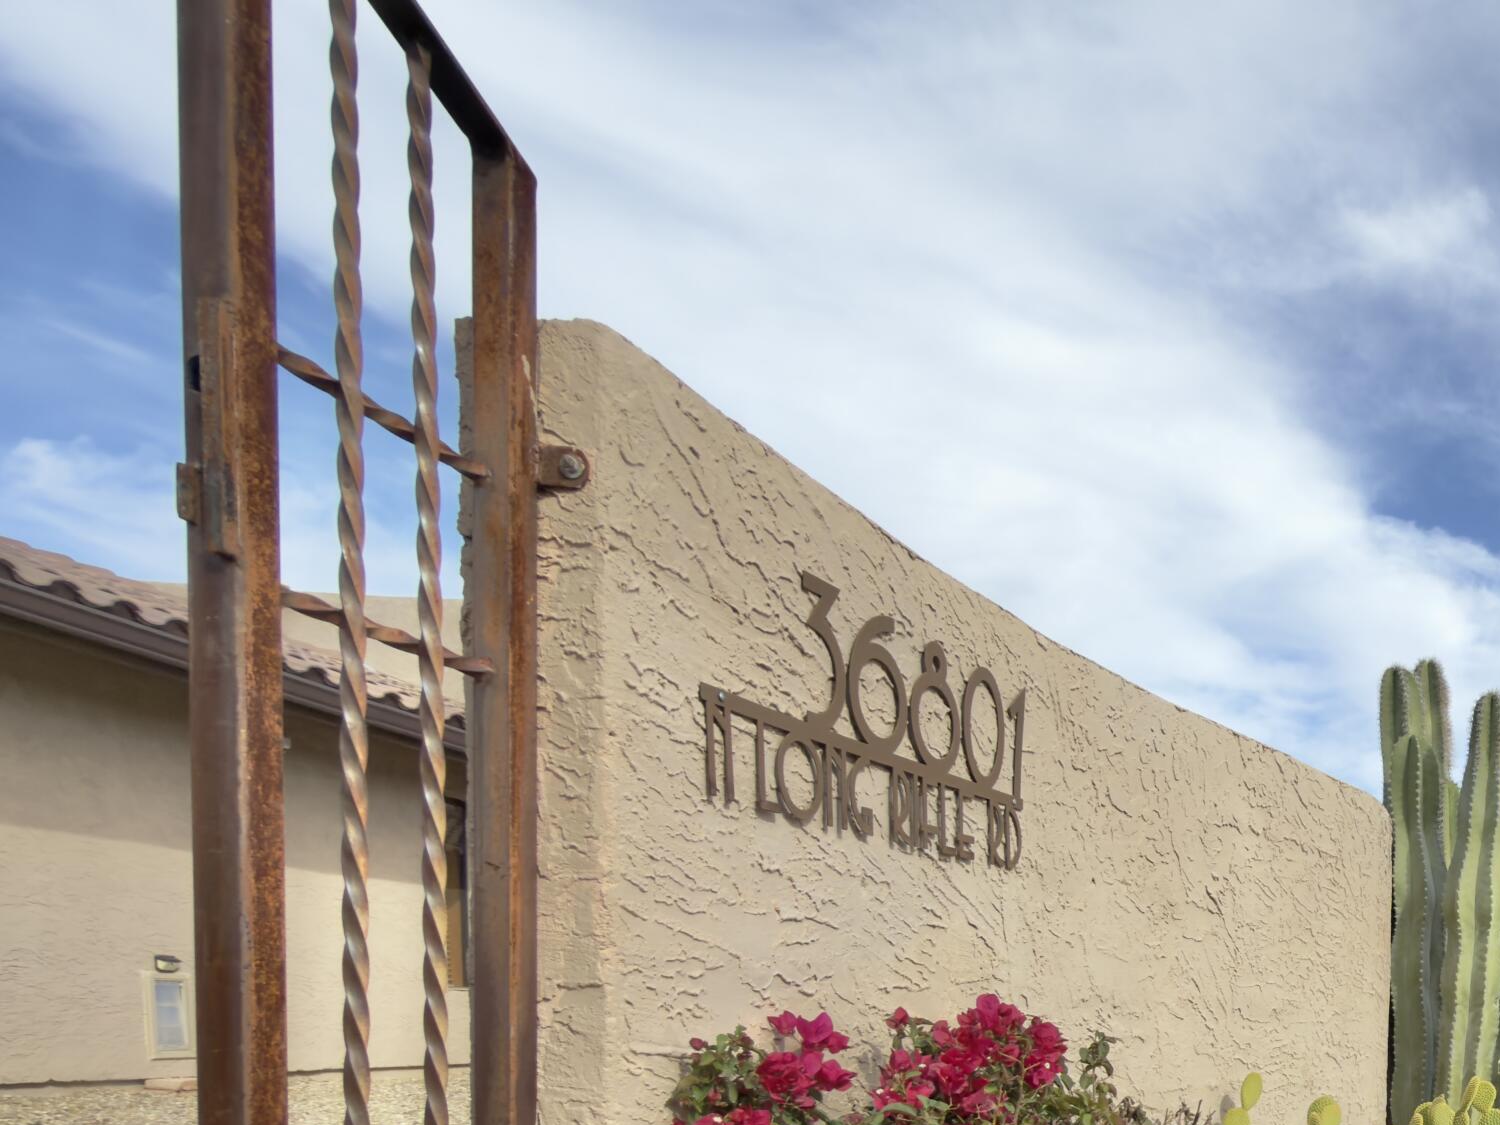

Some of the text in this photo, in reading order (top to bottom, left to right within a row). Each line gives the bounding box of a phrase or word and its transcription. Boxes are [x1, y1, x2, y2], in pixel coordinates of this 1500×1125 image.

[801, 570, 1026, 811] 36801
[755, 712, 874, 836] LONG
[890, 764, 975, 861] RIFLE
[987, 794, 1022, 871] RD
